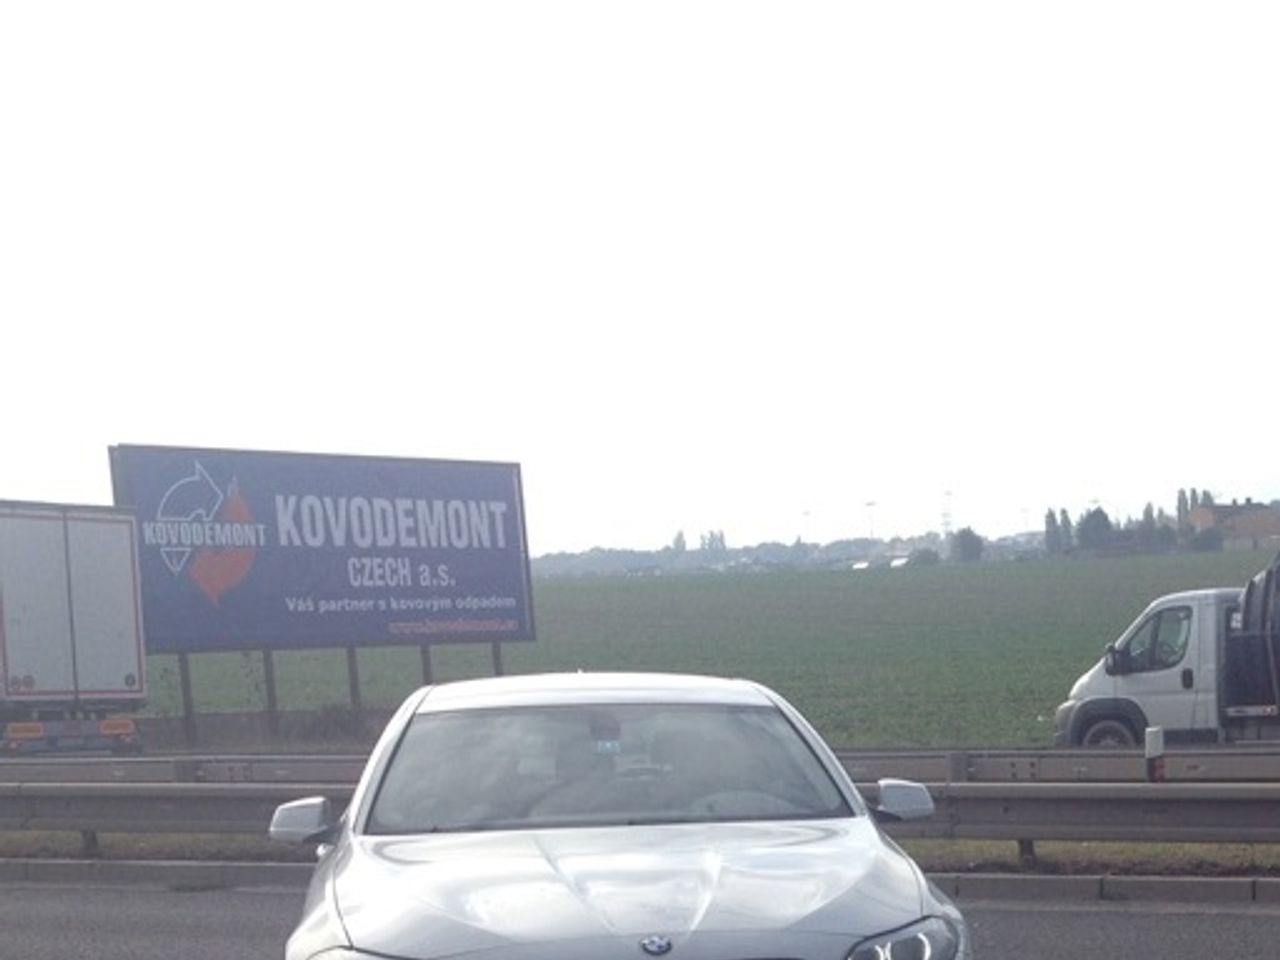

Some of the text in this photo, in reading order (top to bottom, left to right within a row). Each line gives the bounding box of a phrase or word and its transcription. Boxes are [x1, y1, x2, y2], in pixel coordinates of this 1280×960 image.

[142, 521, 266, 547] KOVODEMONT
[275, 494, 508, 549] KOVODEMONT
[347, 557, 457, 587] CZECH a.s.
[318, 598, 376, 614] partner
